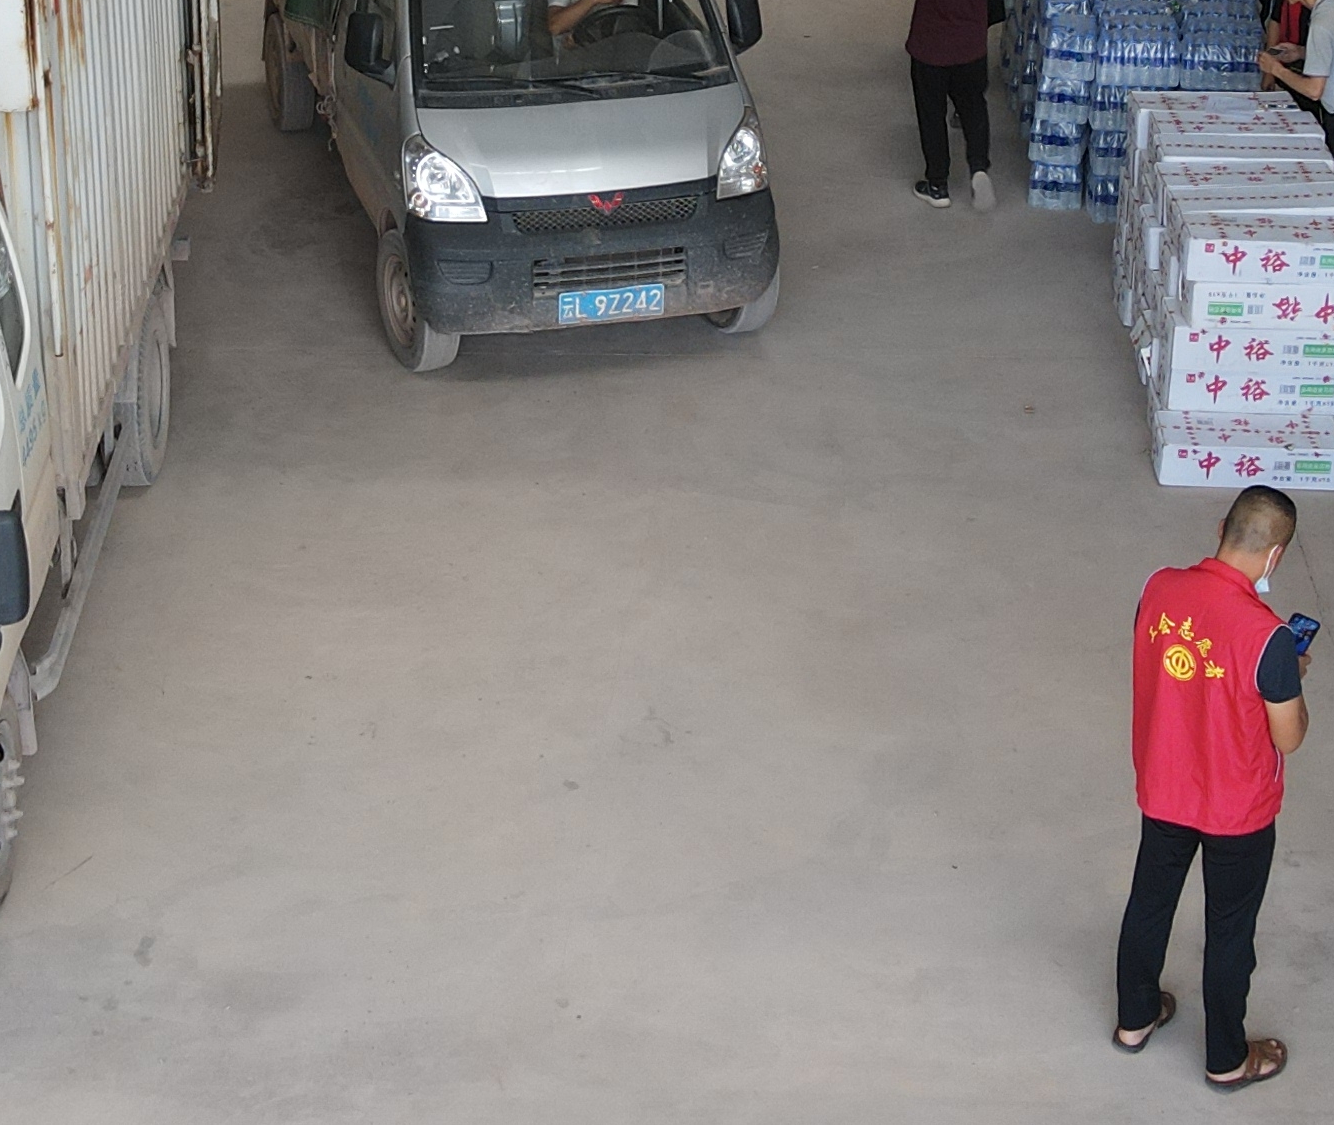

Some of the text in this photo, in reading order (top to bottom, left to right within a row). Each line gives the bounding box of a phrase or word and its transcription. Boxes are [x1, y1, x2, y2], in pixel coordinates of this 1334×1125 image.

[1219, 246, 1290, 275] 中裕
[1209, 335, 1274, 364] 中裕
[1205, 375, 1271, 404] 中裕
[1198, 451, 1265, 480] 中裕
